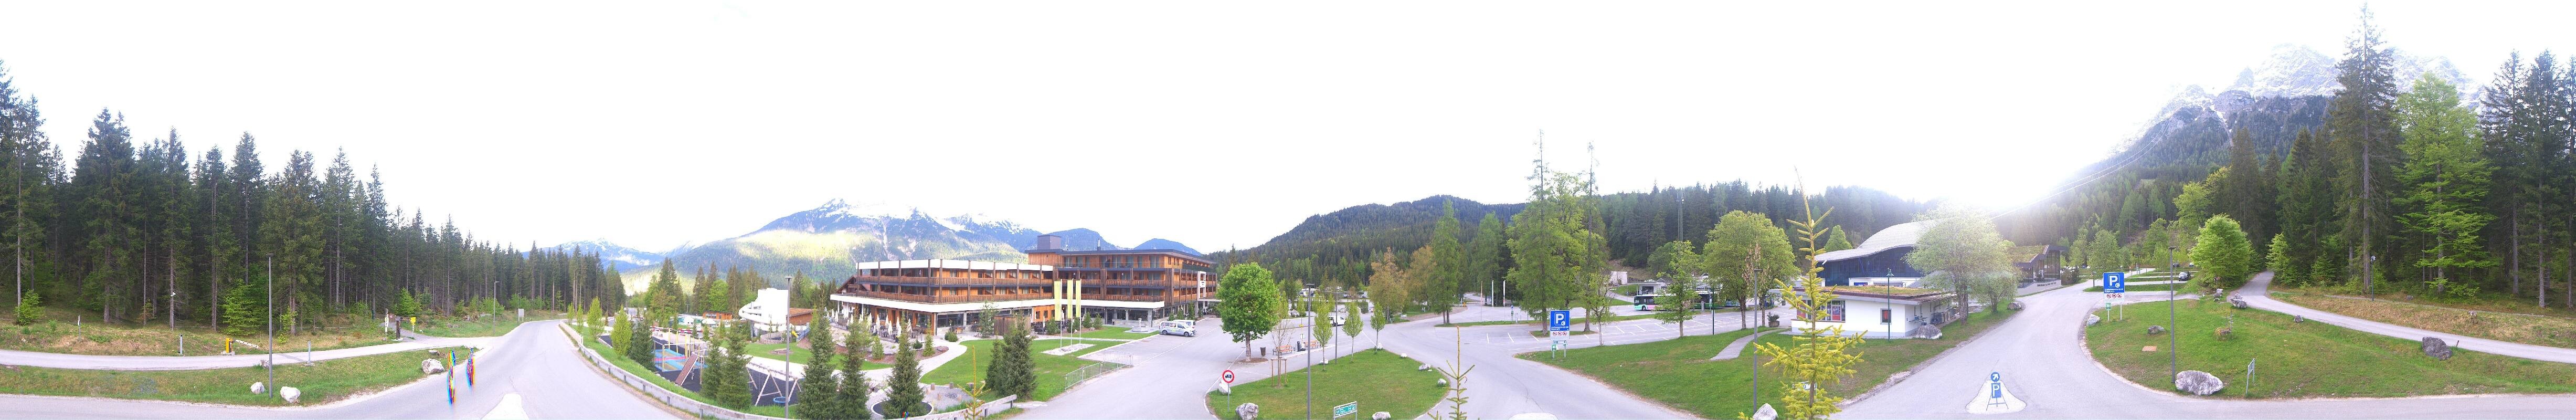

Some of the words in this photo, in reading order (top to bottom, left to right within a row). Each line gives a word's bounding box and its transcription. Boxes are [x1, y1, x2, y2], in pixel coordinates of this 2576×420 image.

[2109, 275, 2118, 286] P
[1555, 313, 1564, 324] P
[1992, 384, 2000, 397] P
